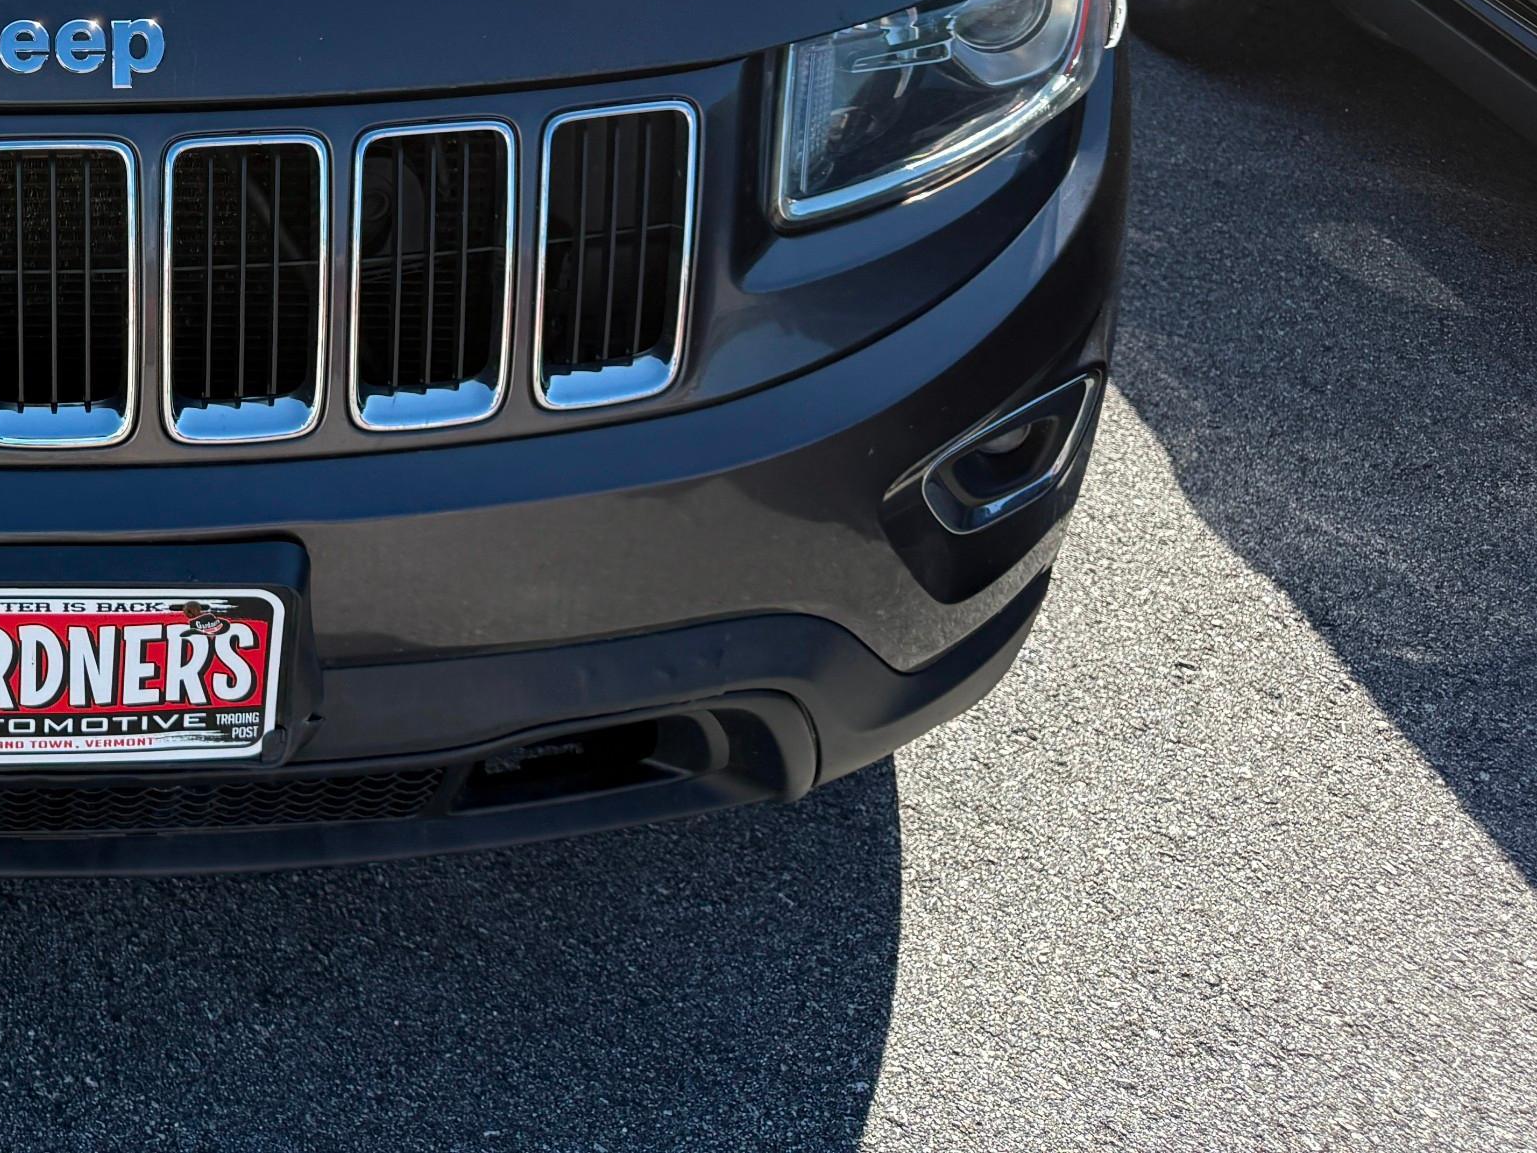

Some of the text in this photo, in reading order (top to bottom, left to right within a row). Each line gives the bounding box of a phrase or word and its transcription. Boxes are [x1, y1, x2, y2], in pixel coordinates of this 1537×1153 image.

[63, 602, 86, 613] IS
[96, 602, 165, 613] BACK
[215, 711, 260, 726] TRADING
[231, 725, 259, 739] POST
[85, 737, 155, 749] VERMONT
